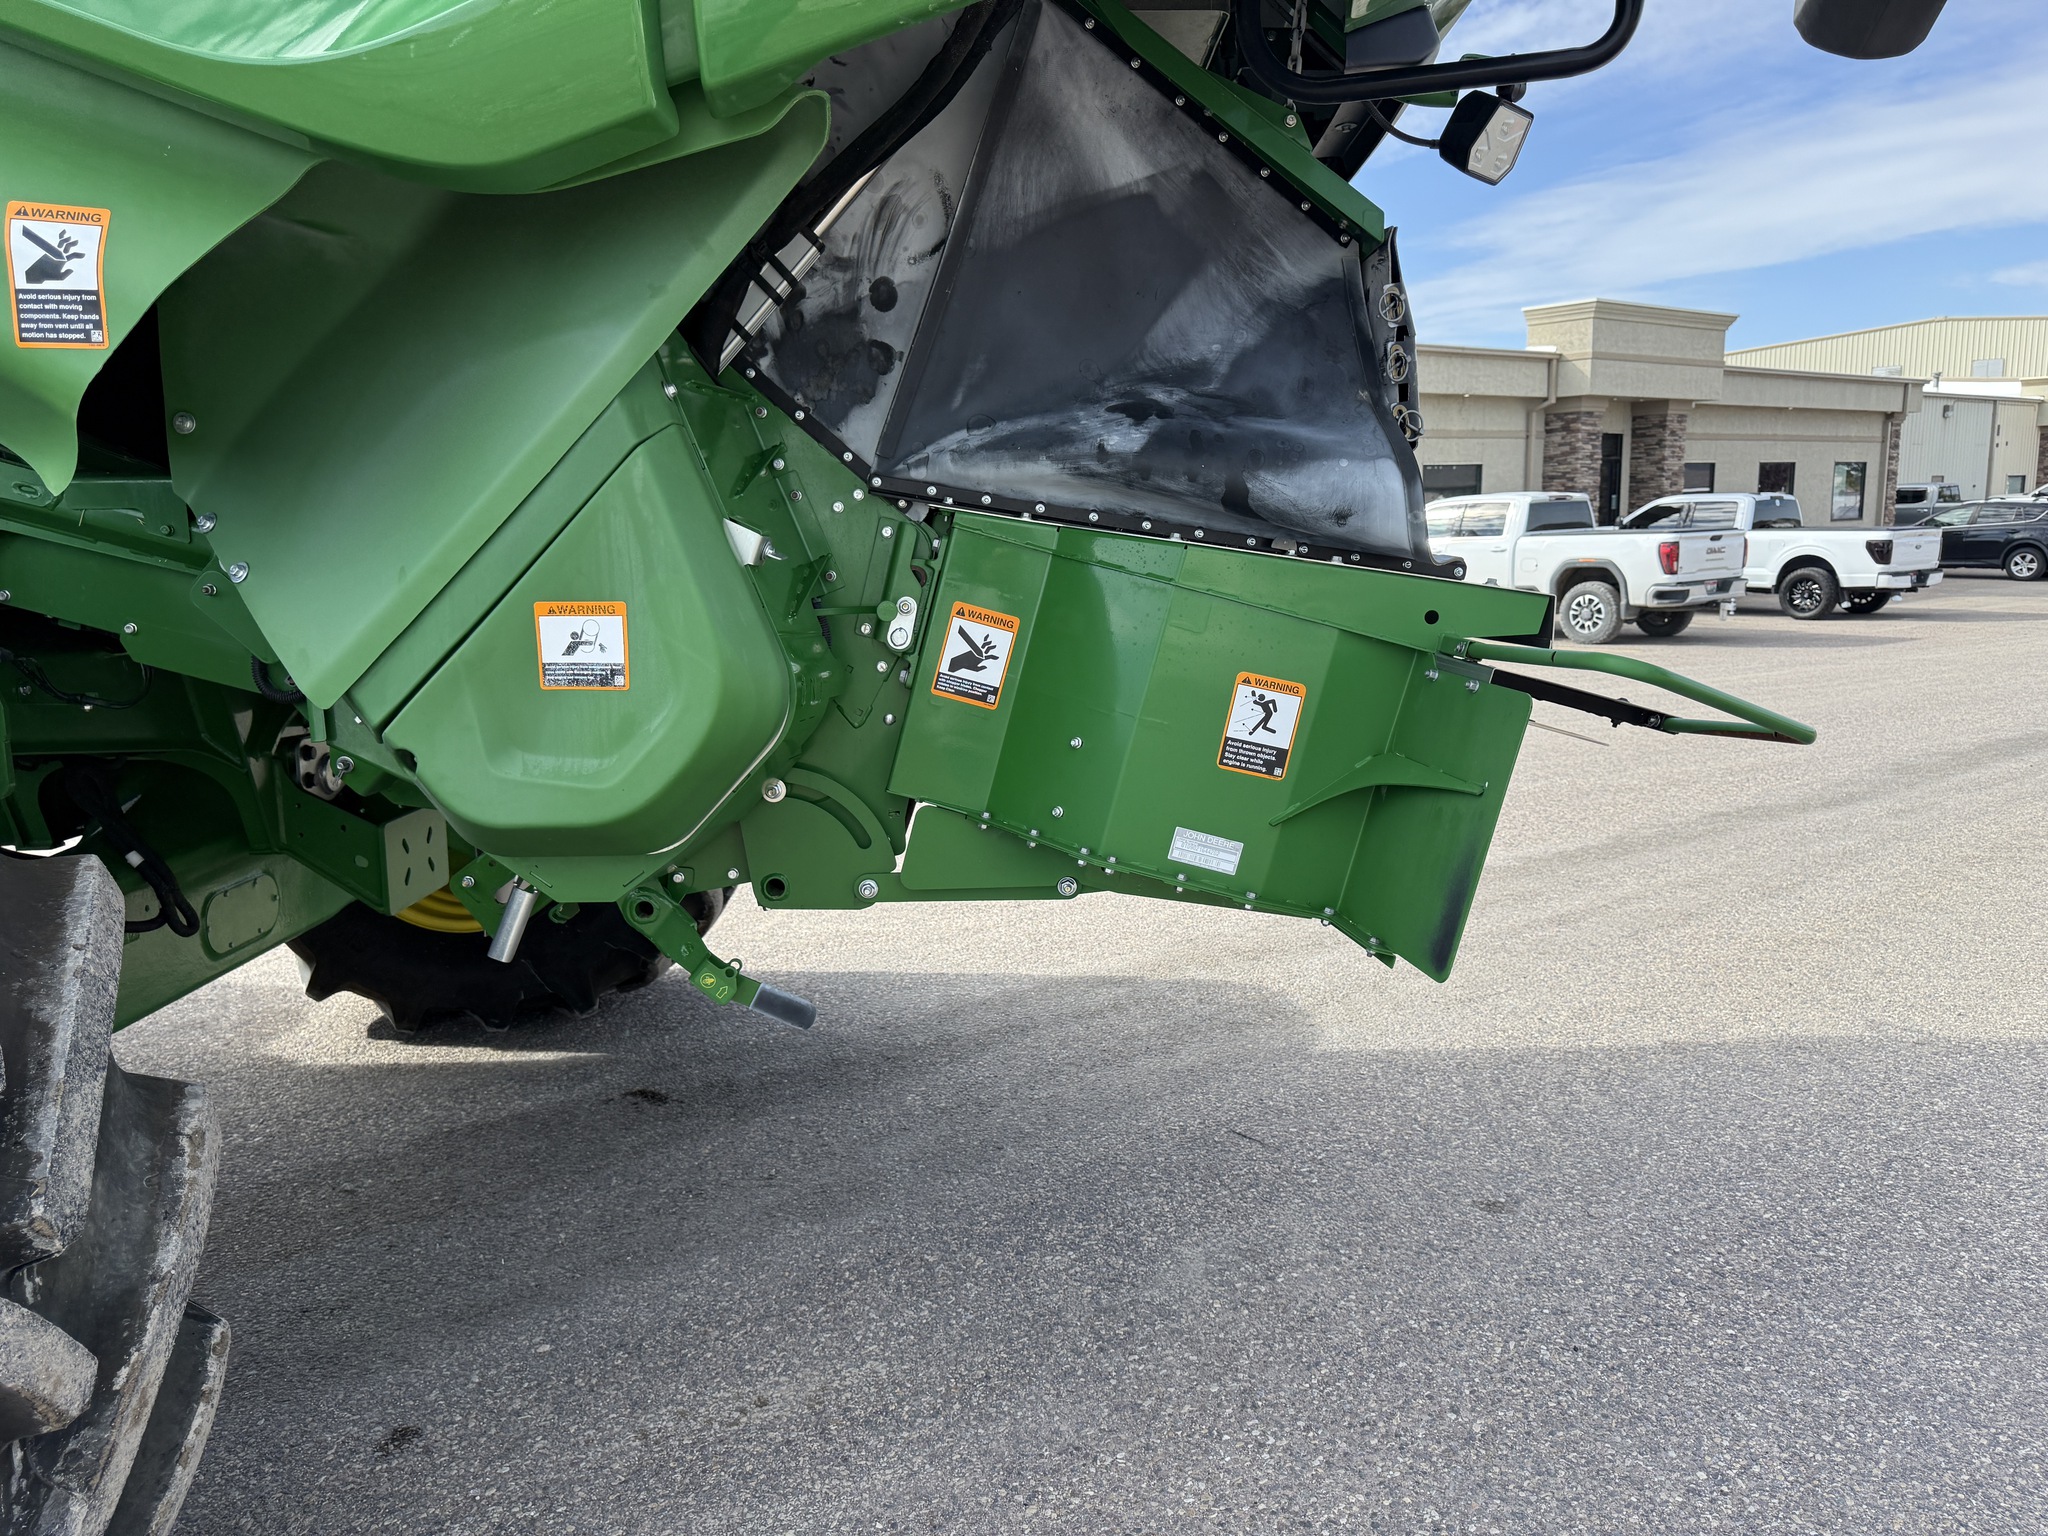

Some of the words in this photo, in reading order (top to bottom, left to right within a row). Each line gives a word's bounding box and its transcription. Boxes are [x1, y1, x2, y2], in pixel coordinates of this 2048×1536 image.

[31, 208, 101, 222] WARNING
[557, 605, 616, 614] WARNING
[968, 609, 1014, 629] WARNING
[1255, 678, 1299, 694] WARNING
[1262, 747, 1277, 755] injury
[1183, 831, 1205, 842] JOHN
[1207, 837, 1235, 849] DEERE
